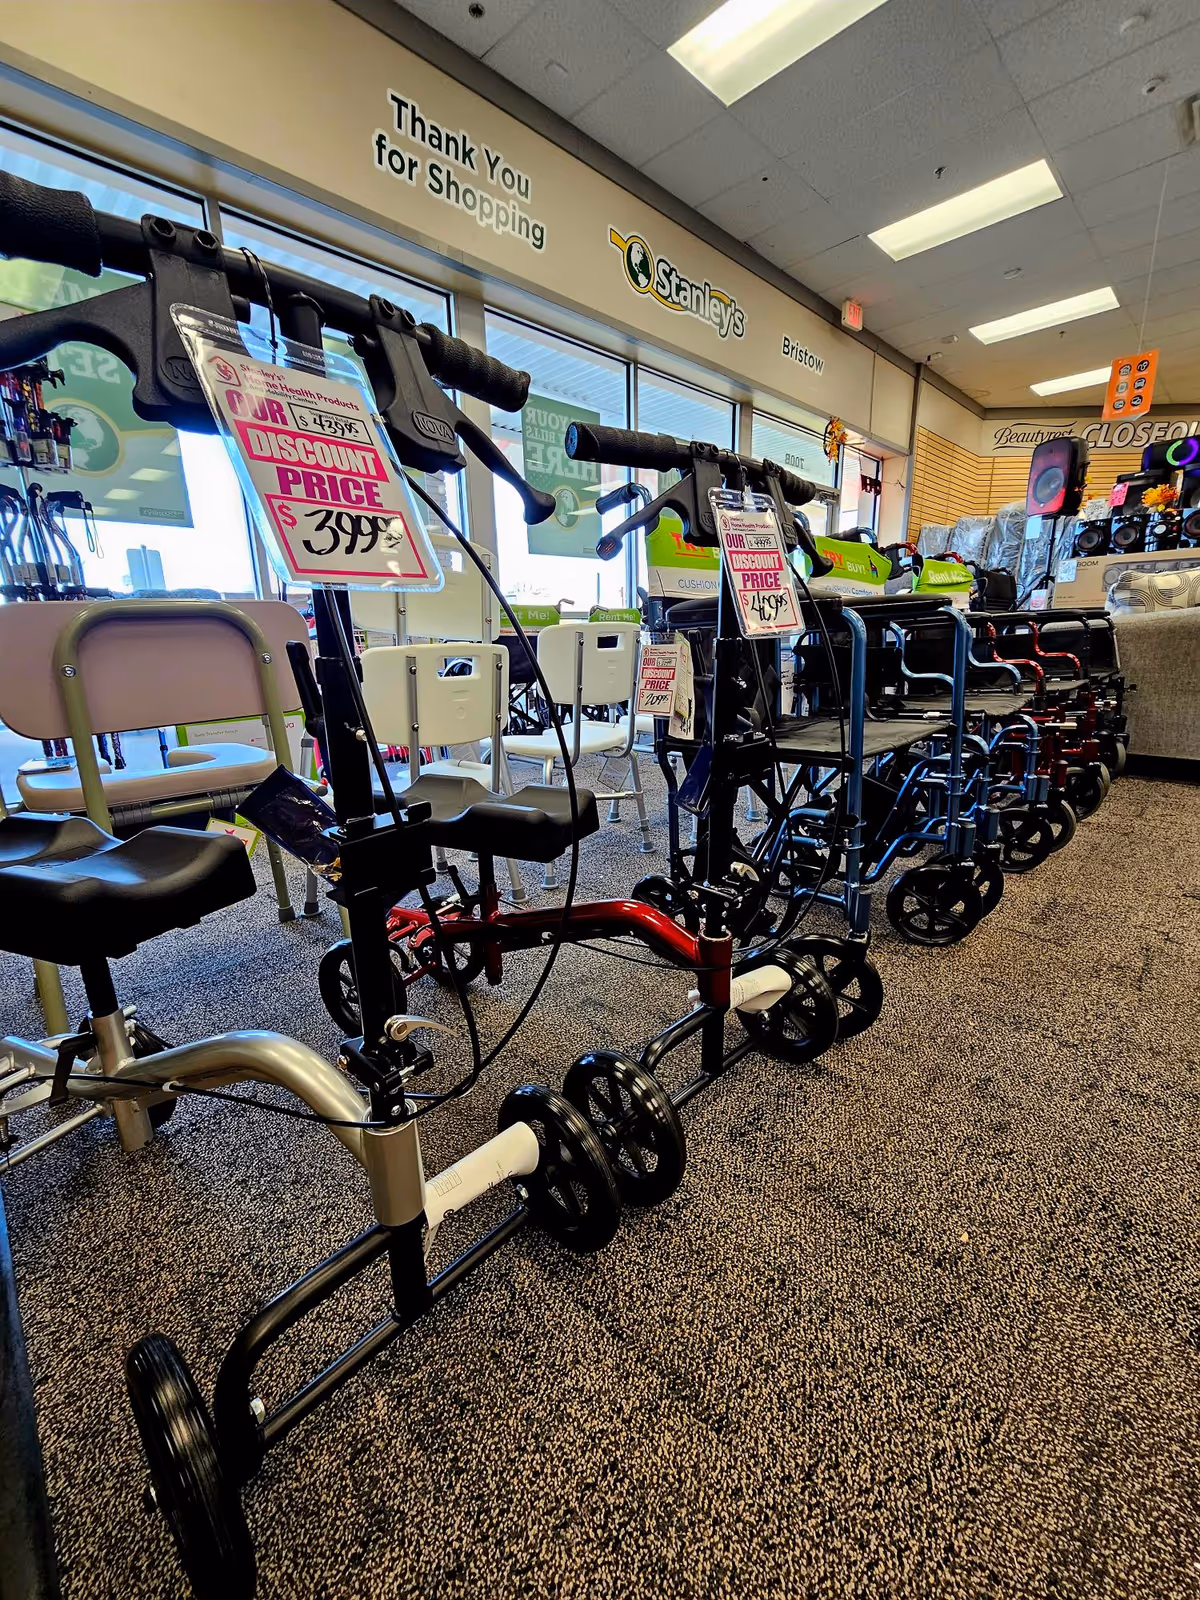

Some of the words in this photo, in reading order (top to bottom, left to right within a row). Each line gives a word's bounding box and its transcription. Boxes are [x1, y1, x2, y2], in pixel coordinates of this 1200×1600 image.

[390, 93, 476, 171] Thank
[484, 148, 530, 200] You
[375, 133, 418, 181] for
[428, 163, 544, 250] Shopping
[656, 258, 745, 338] Stanley's
[782, 336, 824, 372] Bristow
[279, 383, 316, 400] Health
[316, 392, 360, 411] Products
[225, 389, 288, 426] OUR
[299, 415, 309, 428] $
[414, 414, 453, 441] NOVA
[246, 427, 378, 477] DISCOUNT
[276, 465, 383, 507] PRICE
[277, 502, 298, 529] $
[725, 533, 746, 549] OUR
[732, 553, 780, 570] DISCOUNT
[847, 560, 865, 575] BUY!
[1077, 560, 1098, 568] BOOM
[678, 579, 718, 590] CUSHION
[741, 572, 781, 588] PRICE
[928, 570, 950, 584] Rent
[742, 594, 749, 606] $
[600, 613, 621, 621] Rent
[642, 657, 656, 666] OUR
[643, 668, 675, 679] DISCOUNT
[644, 680, 670, 690] PRICE
